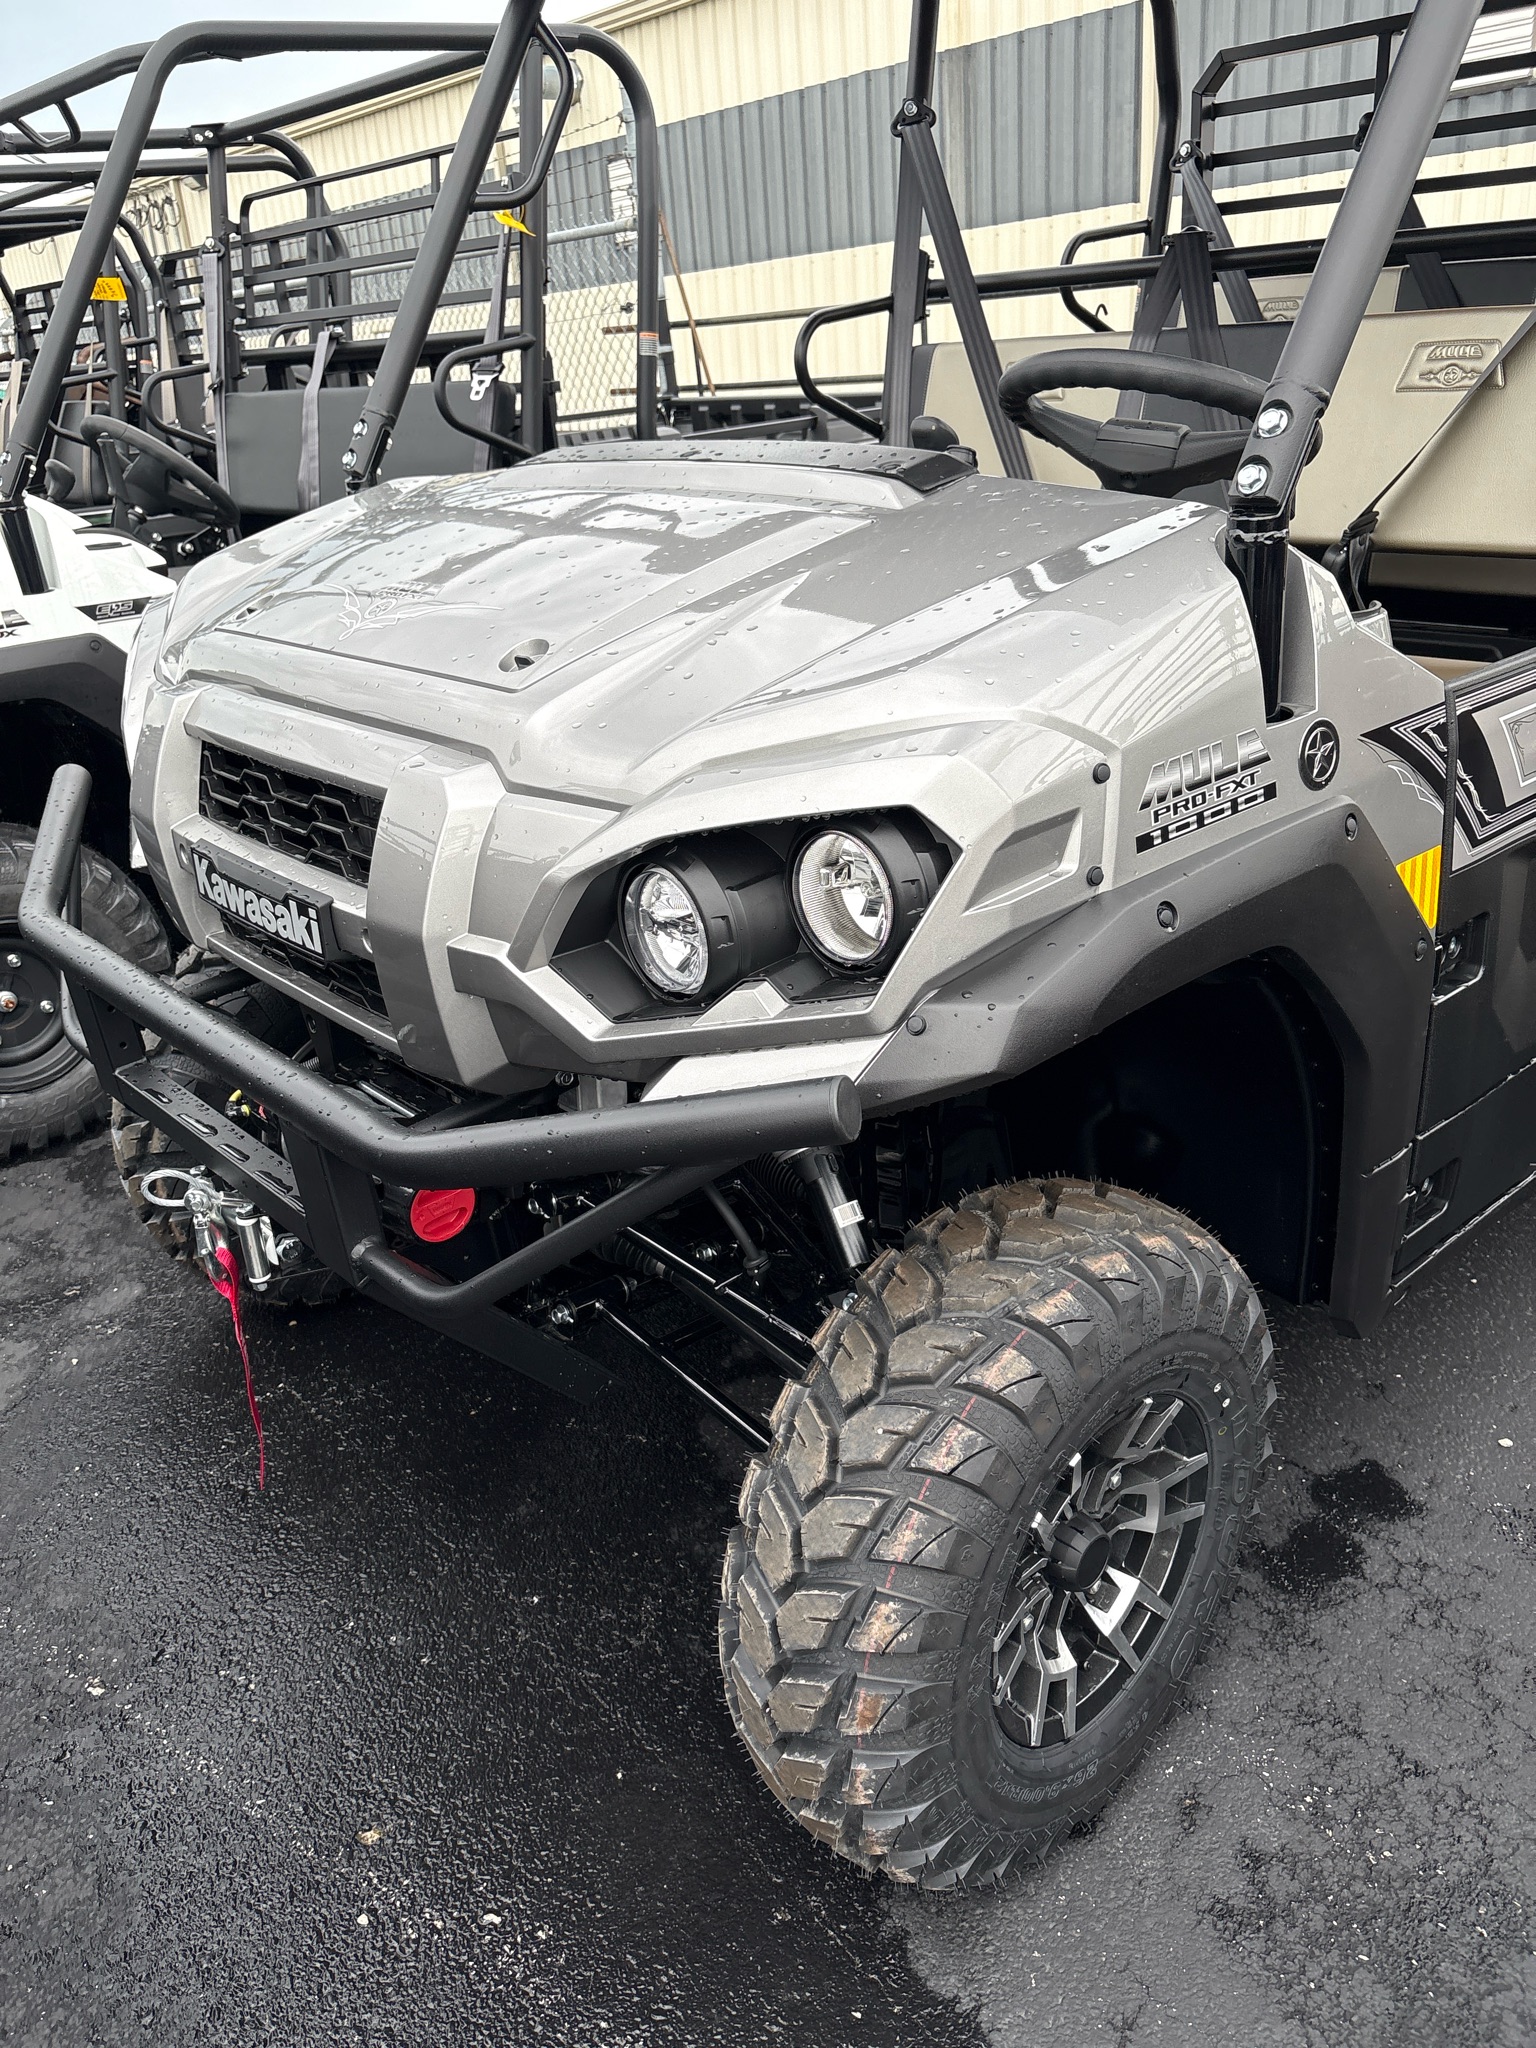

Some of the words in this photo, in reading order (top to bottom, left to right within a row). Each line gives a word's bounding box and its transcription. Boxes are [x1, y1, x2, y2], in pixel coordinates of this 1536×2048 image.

[1427, 344, 1483, 361] MULE
[96, 600, 133, 616] EPS
[1138, 729, 1272, 812] MULE
[1151, 769, 1261, 825] PRO-FXT
[1150, 788, 1265, 846] 1000
[193, 852, 323, 954] Kawasaki
